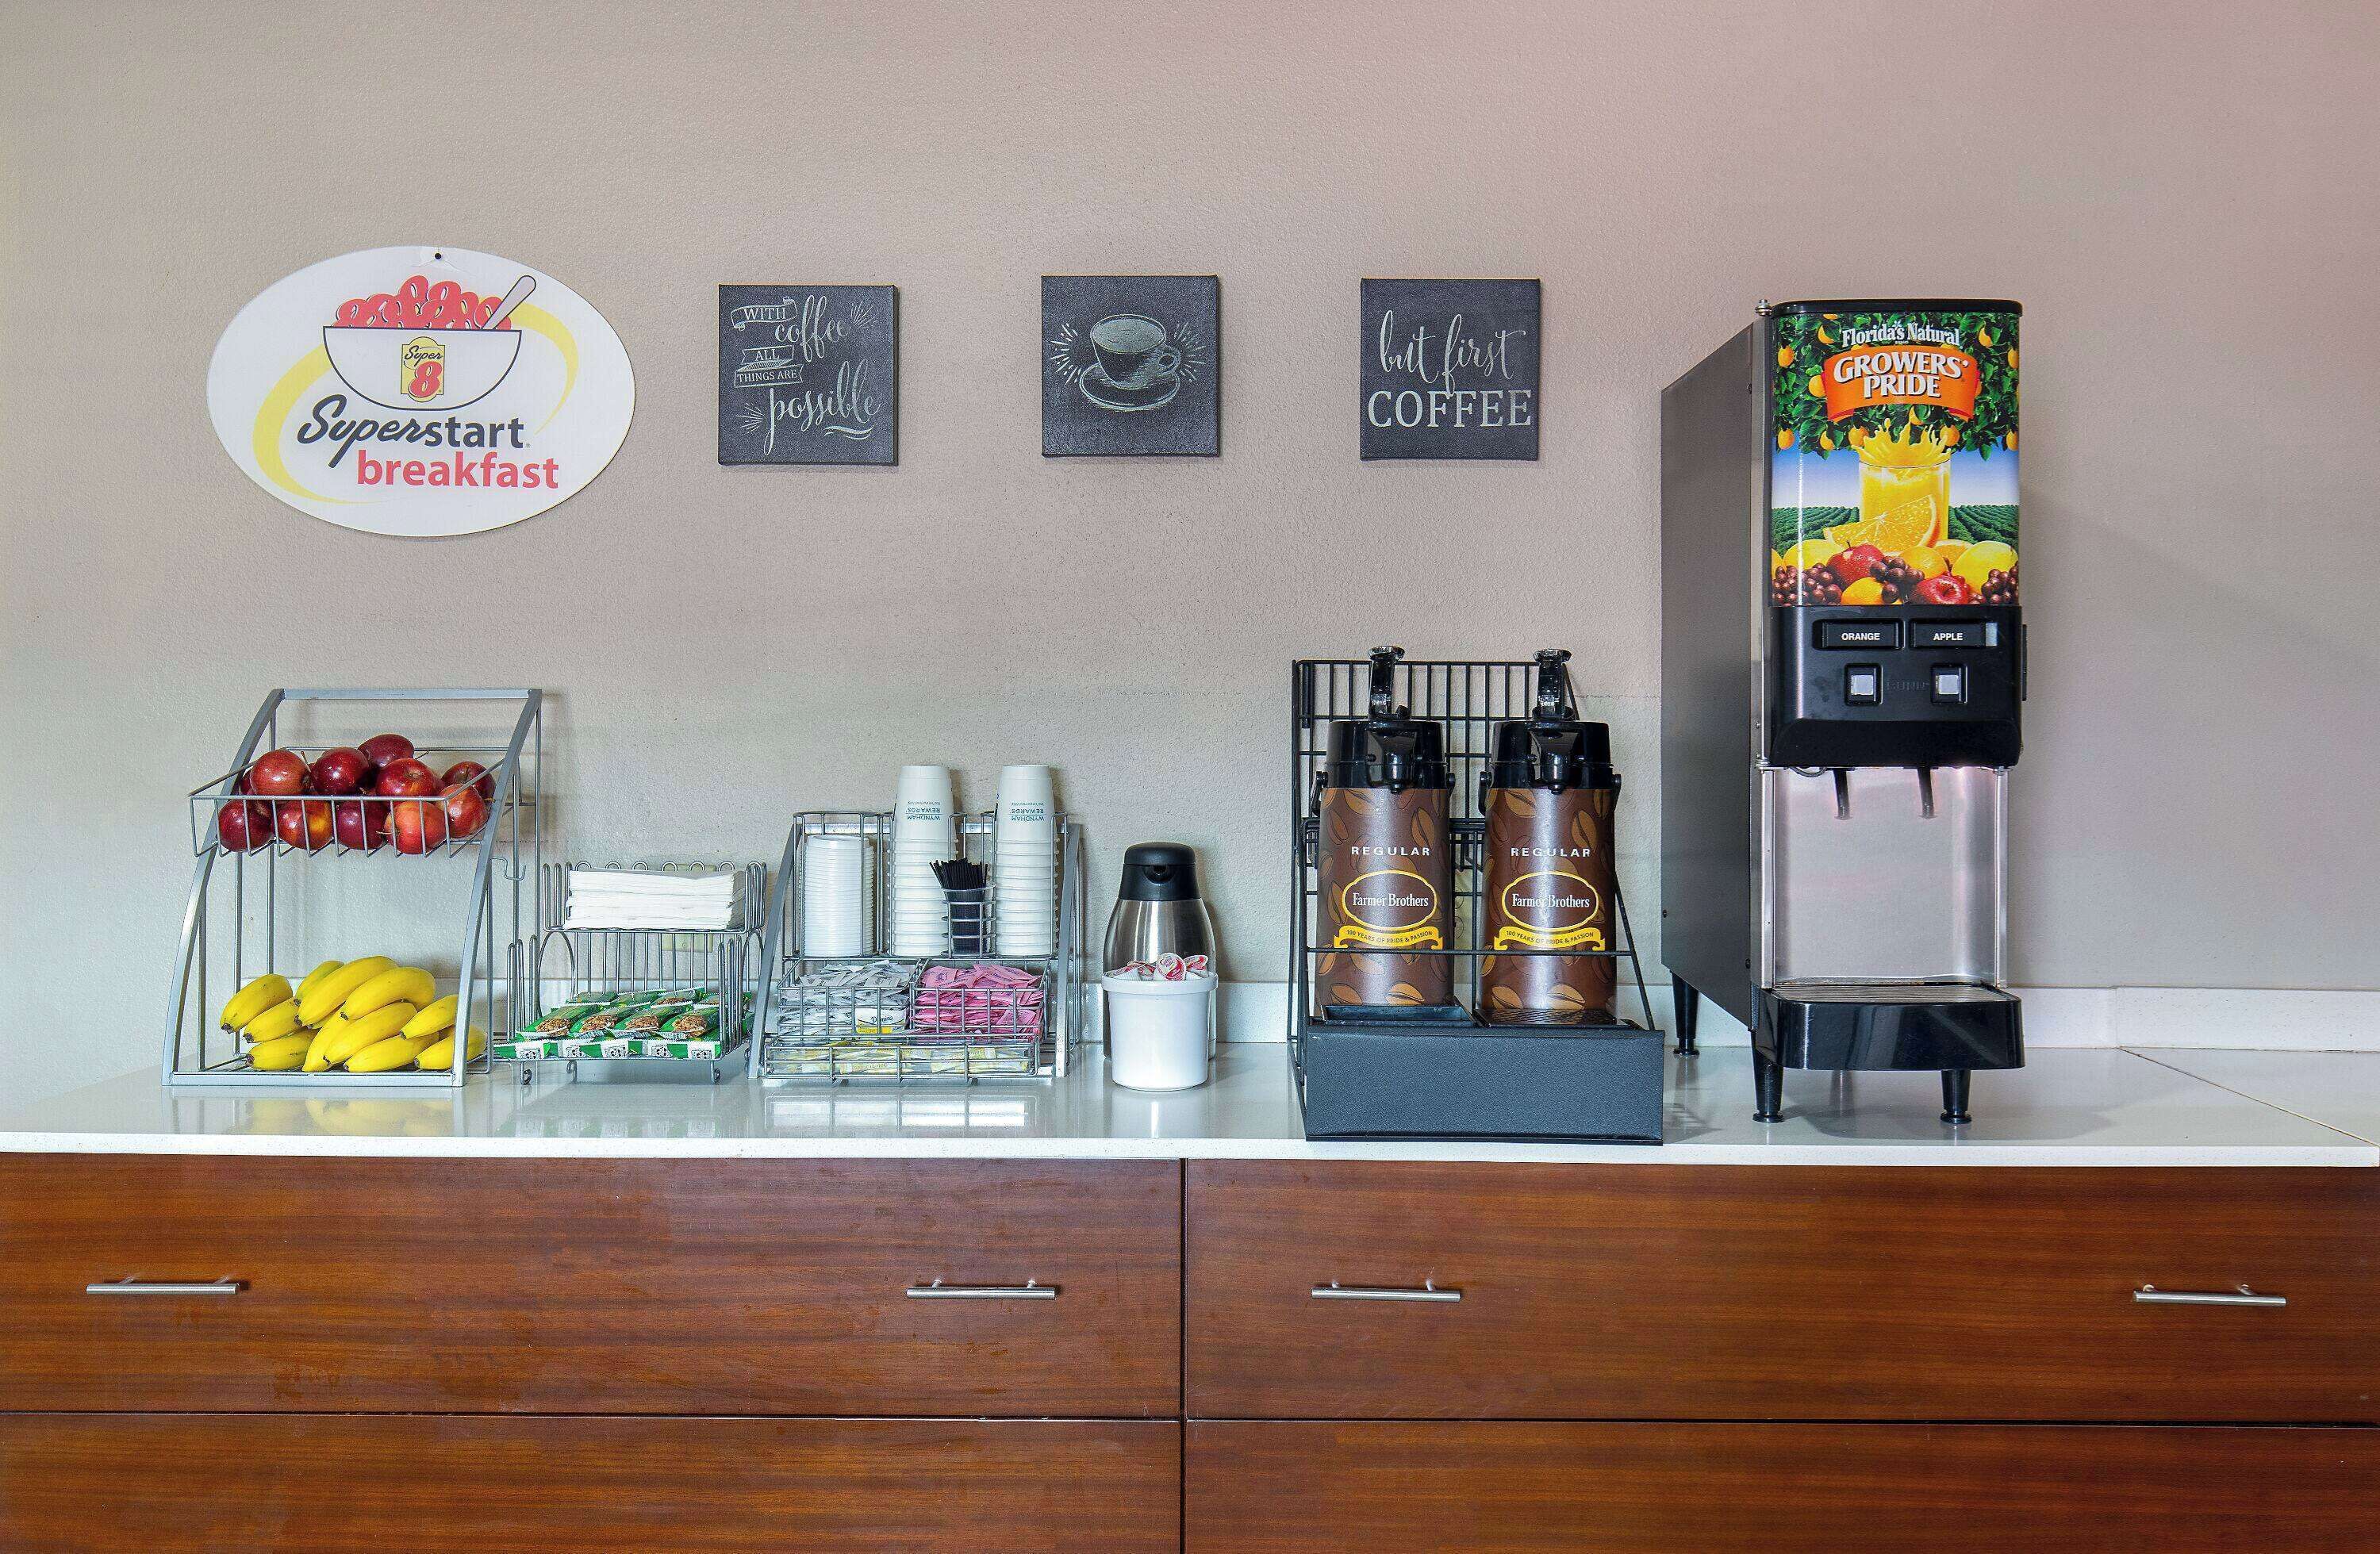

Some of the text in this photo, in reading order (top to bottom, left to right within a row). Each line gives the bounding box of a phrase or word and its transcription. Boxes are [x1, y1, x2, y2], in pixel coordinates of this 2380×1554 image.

[743, 307, 786, 320] WITH
[774, 294, 850, 363] coffee
[1841, 322, 1961, 348] Florida's Natural
[404, 344, 443, 367] Super
[754, 348, 780, 362] ALL
[1380, 309, 1526, 397] but first
[1833, 351, 1971, 384] GROWERS'
[407, 360, 443, 398] 8
[736, 369, 797, 383] THINGS ARE
[1864, 374, 1942, 398] PRIDE
[763, 358, 881, 456] possible
[1368, 389, 1532, 428] COFFEE
[357, 449, 559, 489] breakfast
[1841, 632, 1881, 641] ORANGE
[1933, 632, 1964, 641] APPLE
[1351, 846, 1430, 856] REGULAR
[1511, 847, 1591, 858] REGULAR
[1352, 892, 1429, 907] Farmer Brothers
[1511, 893, 1591, 907] Farmer Brothers
[1357, 931, 1375, 942] YEARS
[1411, 930, 1434, 941] PASSION
[1516, 933, 1534, 942] YEARS
[1570, 931, 1594, 942] PASSION
